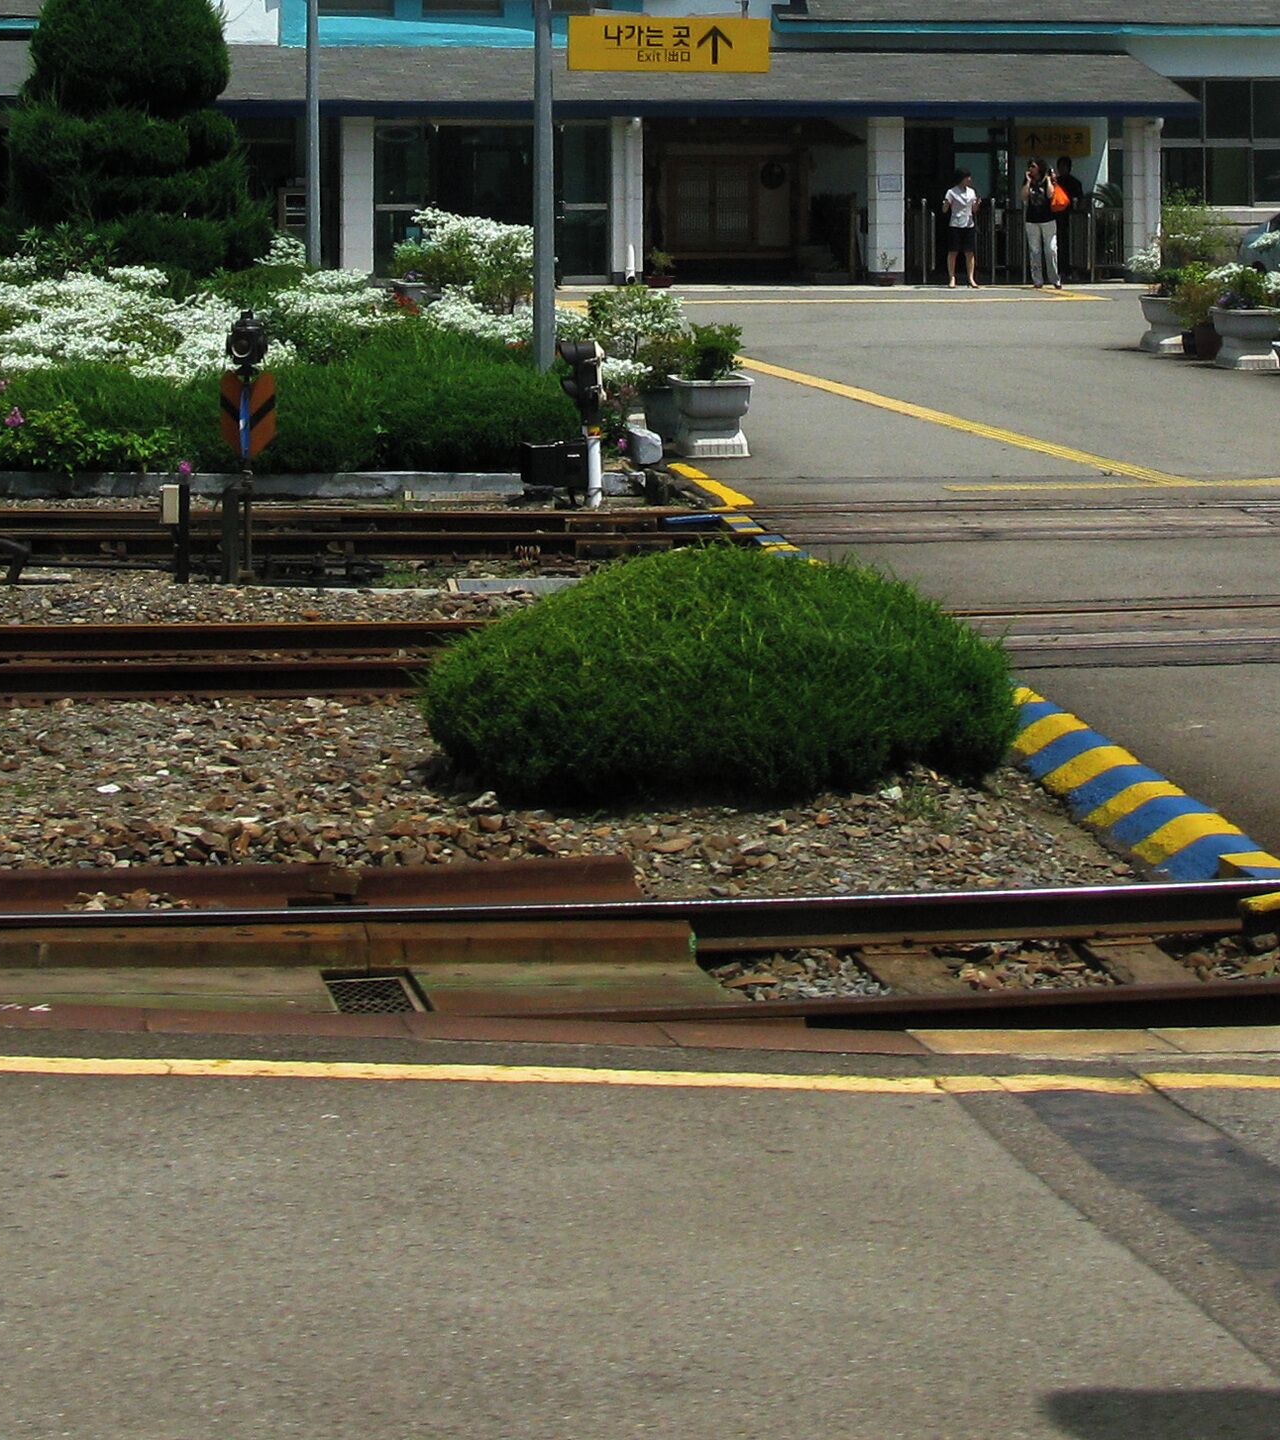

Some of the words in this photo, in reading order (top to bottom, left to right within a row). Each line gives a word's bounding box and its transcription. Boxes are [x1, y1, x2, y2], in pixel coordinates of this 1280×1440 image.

[604, 25, 663, 47] 나가는
[672, 25, 690, 47] 곳
[637, 50, 661, 63] Exit
